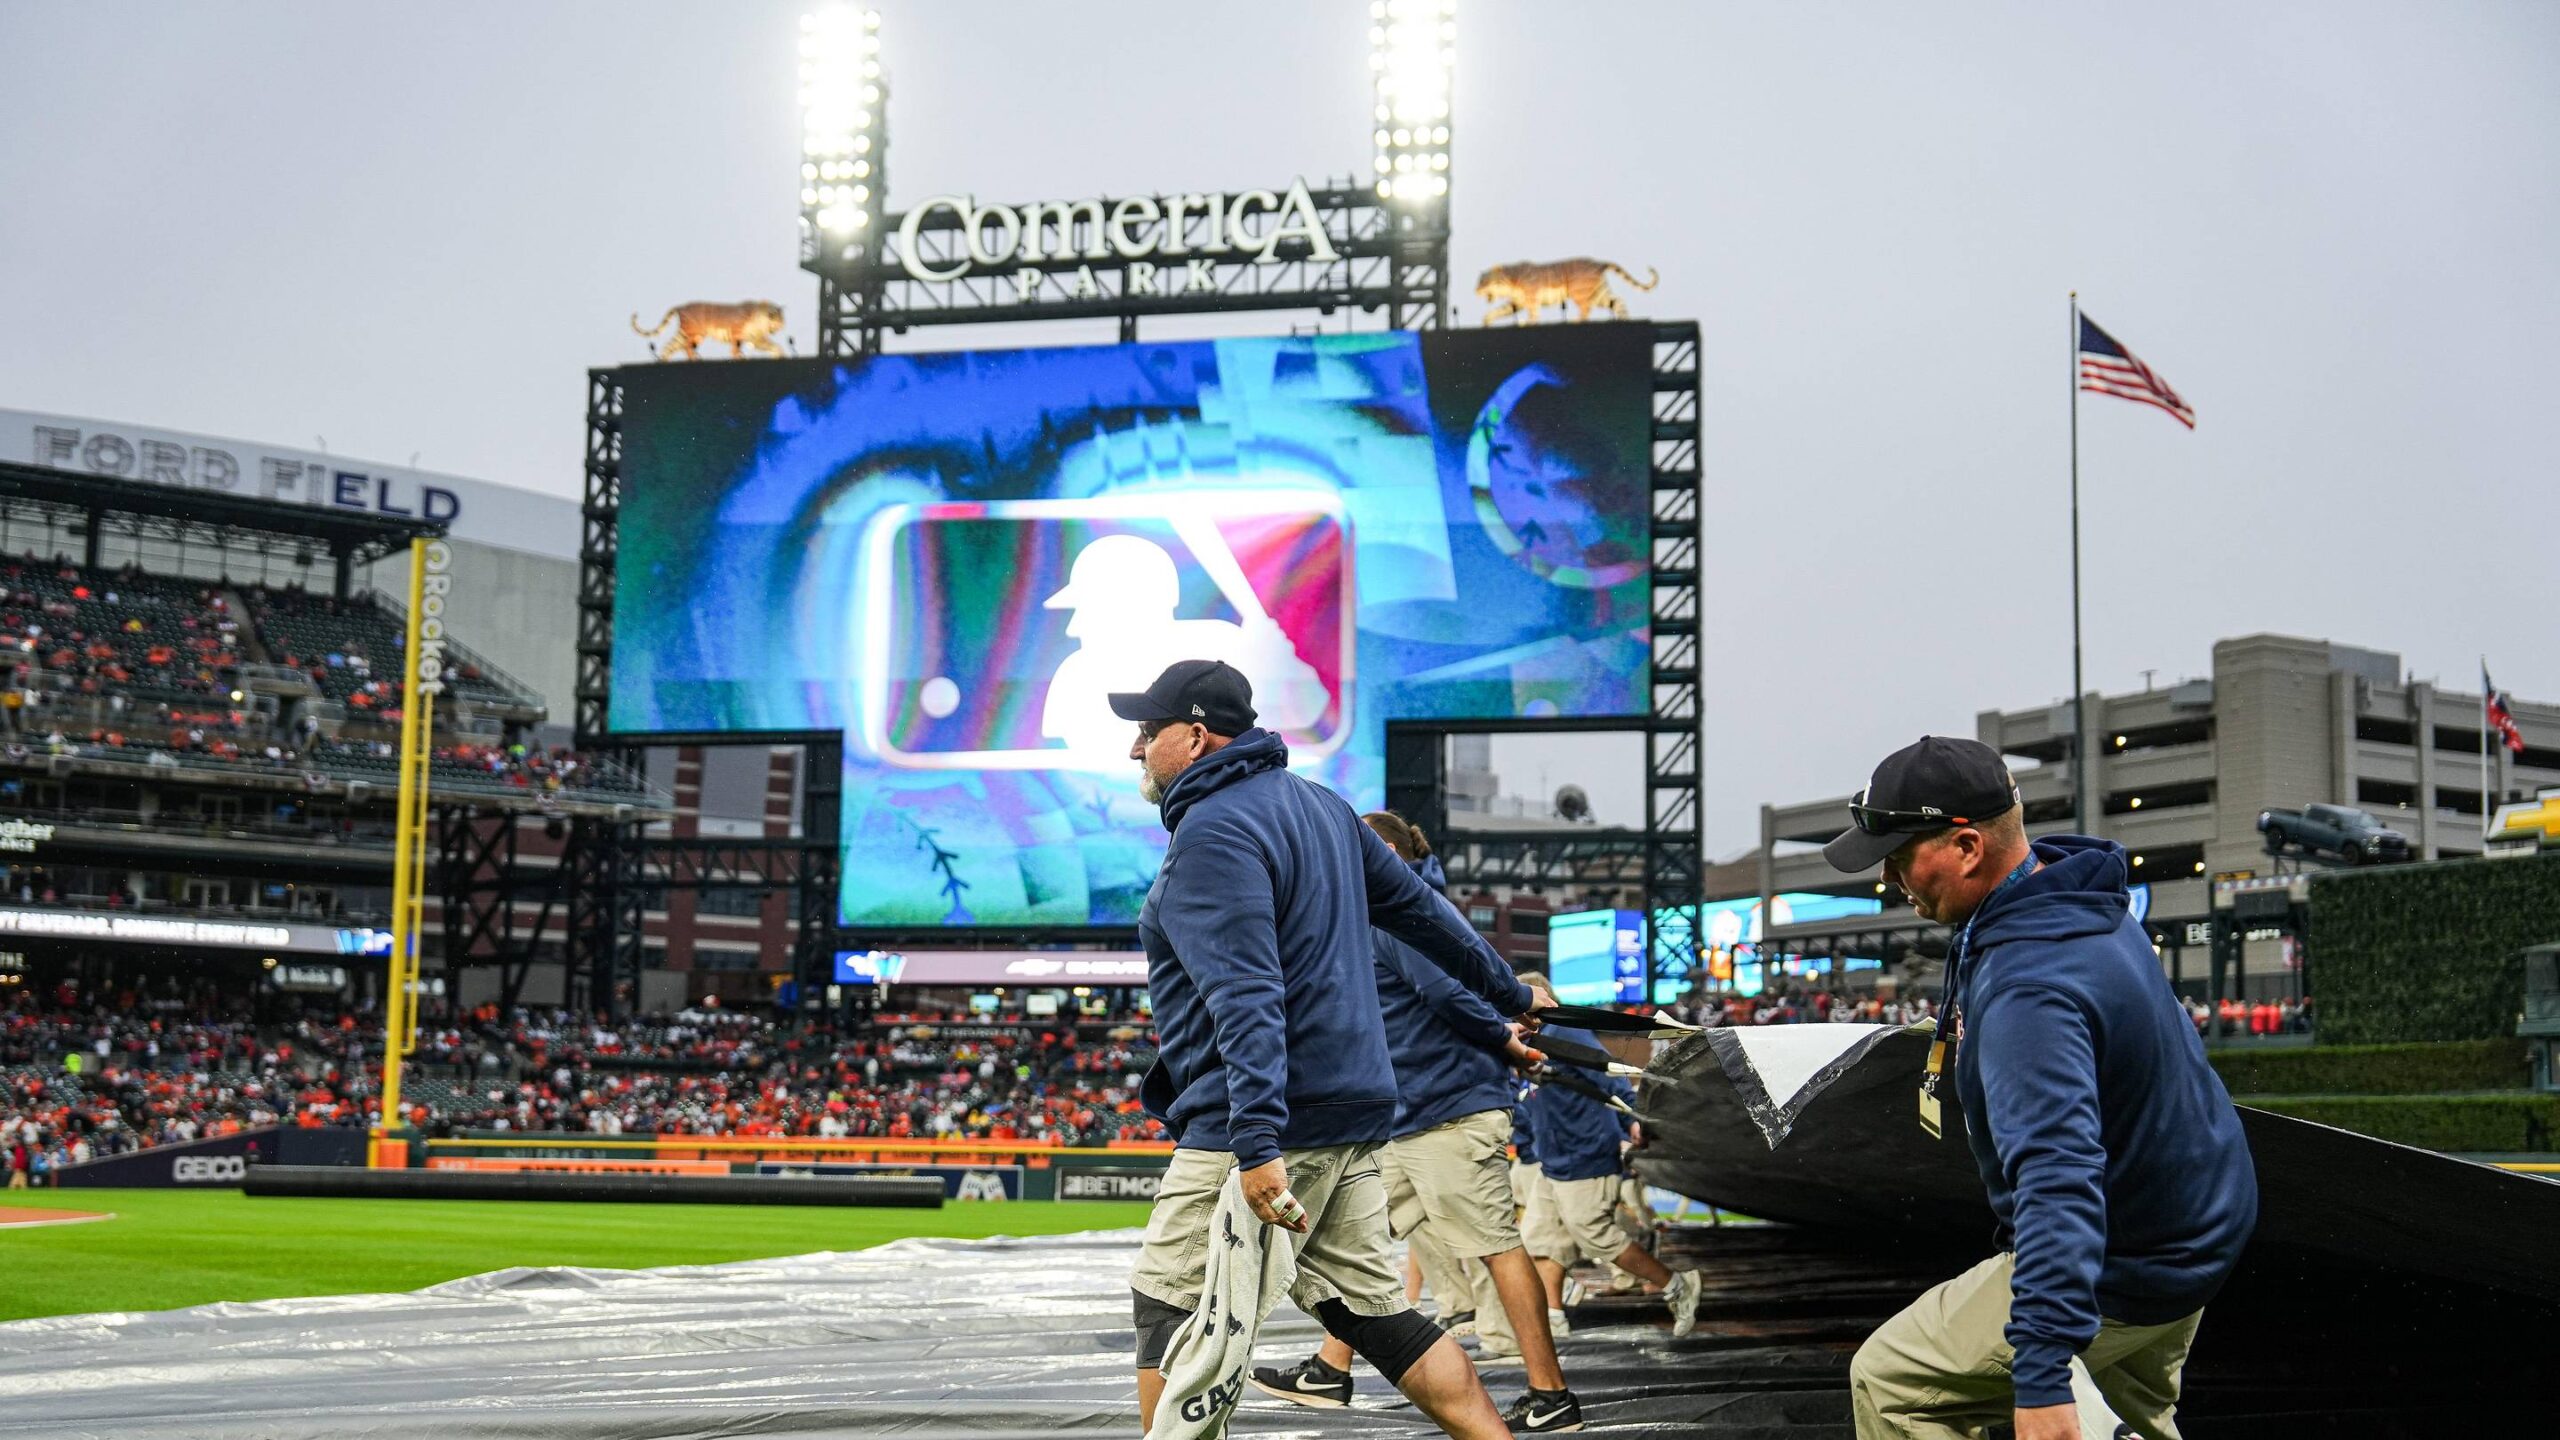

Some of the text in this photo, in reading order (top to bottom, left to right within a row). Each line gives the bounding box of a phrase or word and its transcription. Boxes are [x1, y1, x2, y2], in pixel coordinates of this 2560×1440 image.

[1017, 258, 1218, 301] PARK
[34, 425, 460, 523] FORD FIELD
[408, 574, 451, 696] Rocket
[173, 1156, 246, 1182] GEICO
